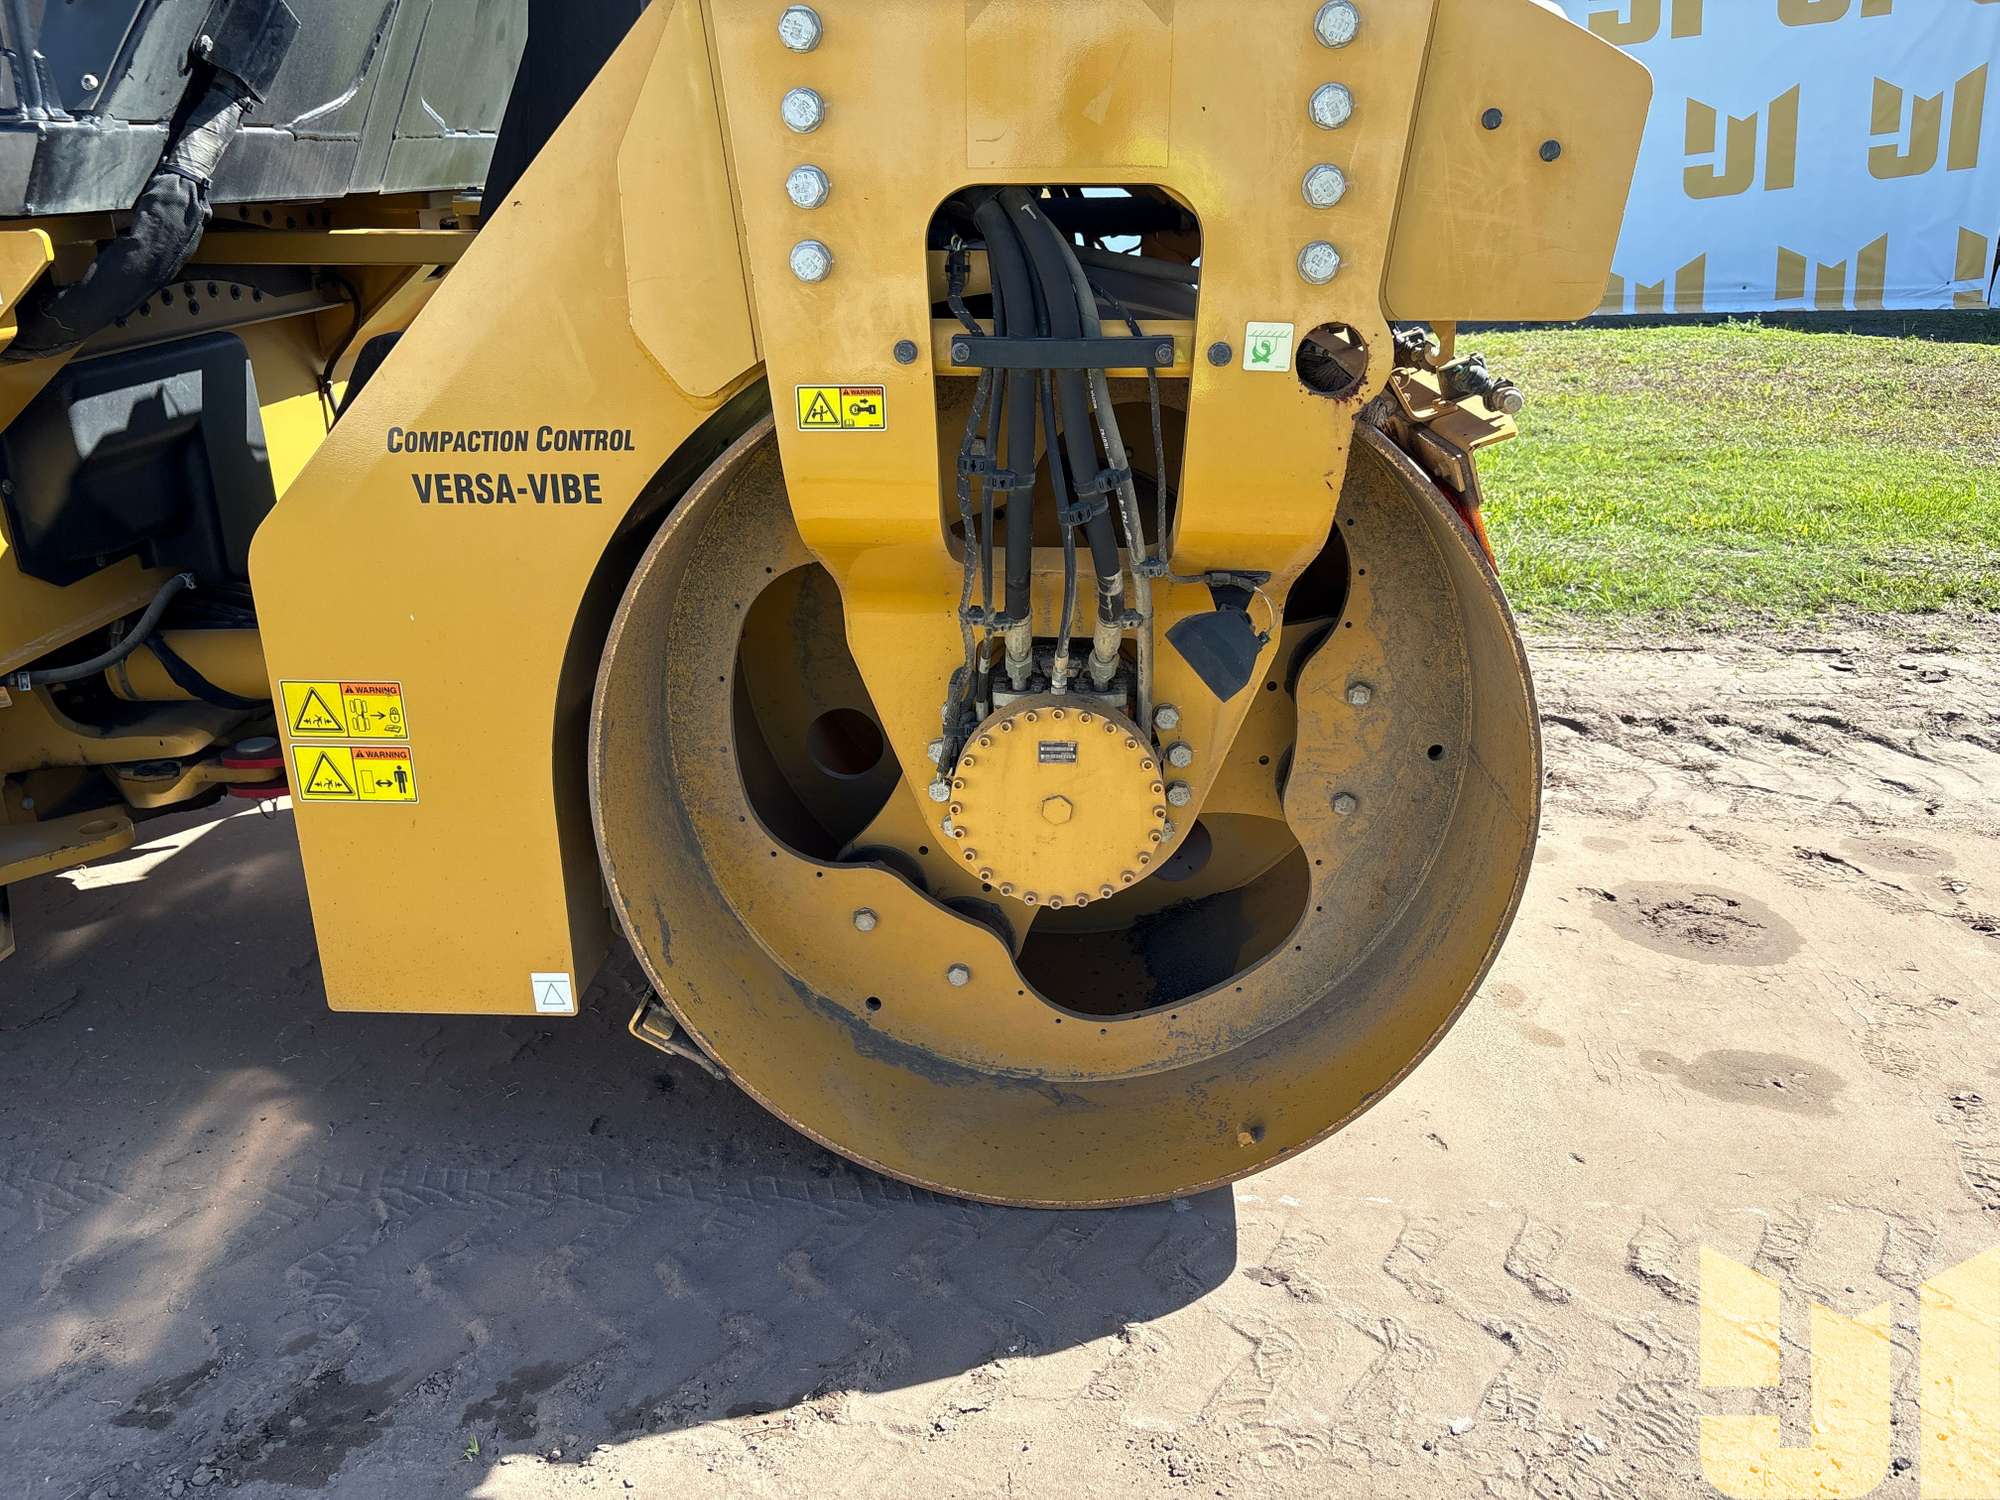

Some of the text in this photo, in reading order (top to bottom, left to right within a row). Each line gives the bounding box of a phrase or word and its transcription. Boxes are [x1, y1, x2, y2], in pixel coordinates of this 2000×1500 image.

[387, 425, 636, 453] COMPACTION CONTROL
[411, 473, 603, 504] VERSA-VIBE
[355, 686, 397, 694] WARNING
[366, 751, 407, 759] WARNING
